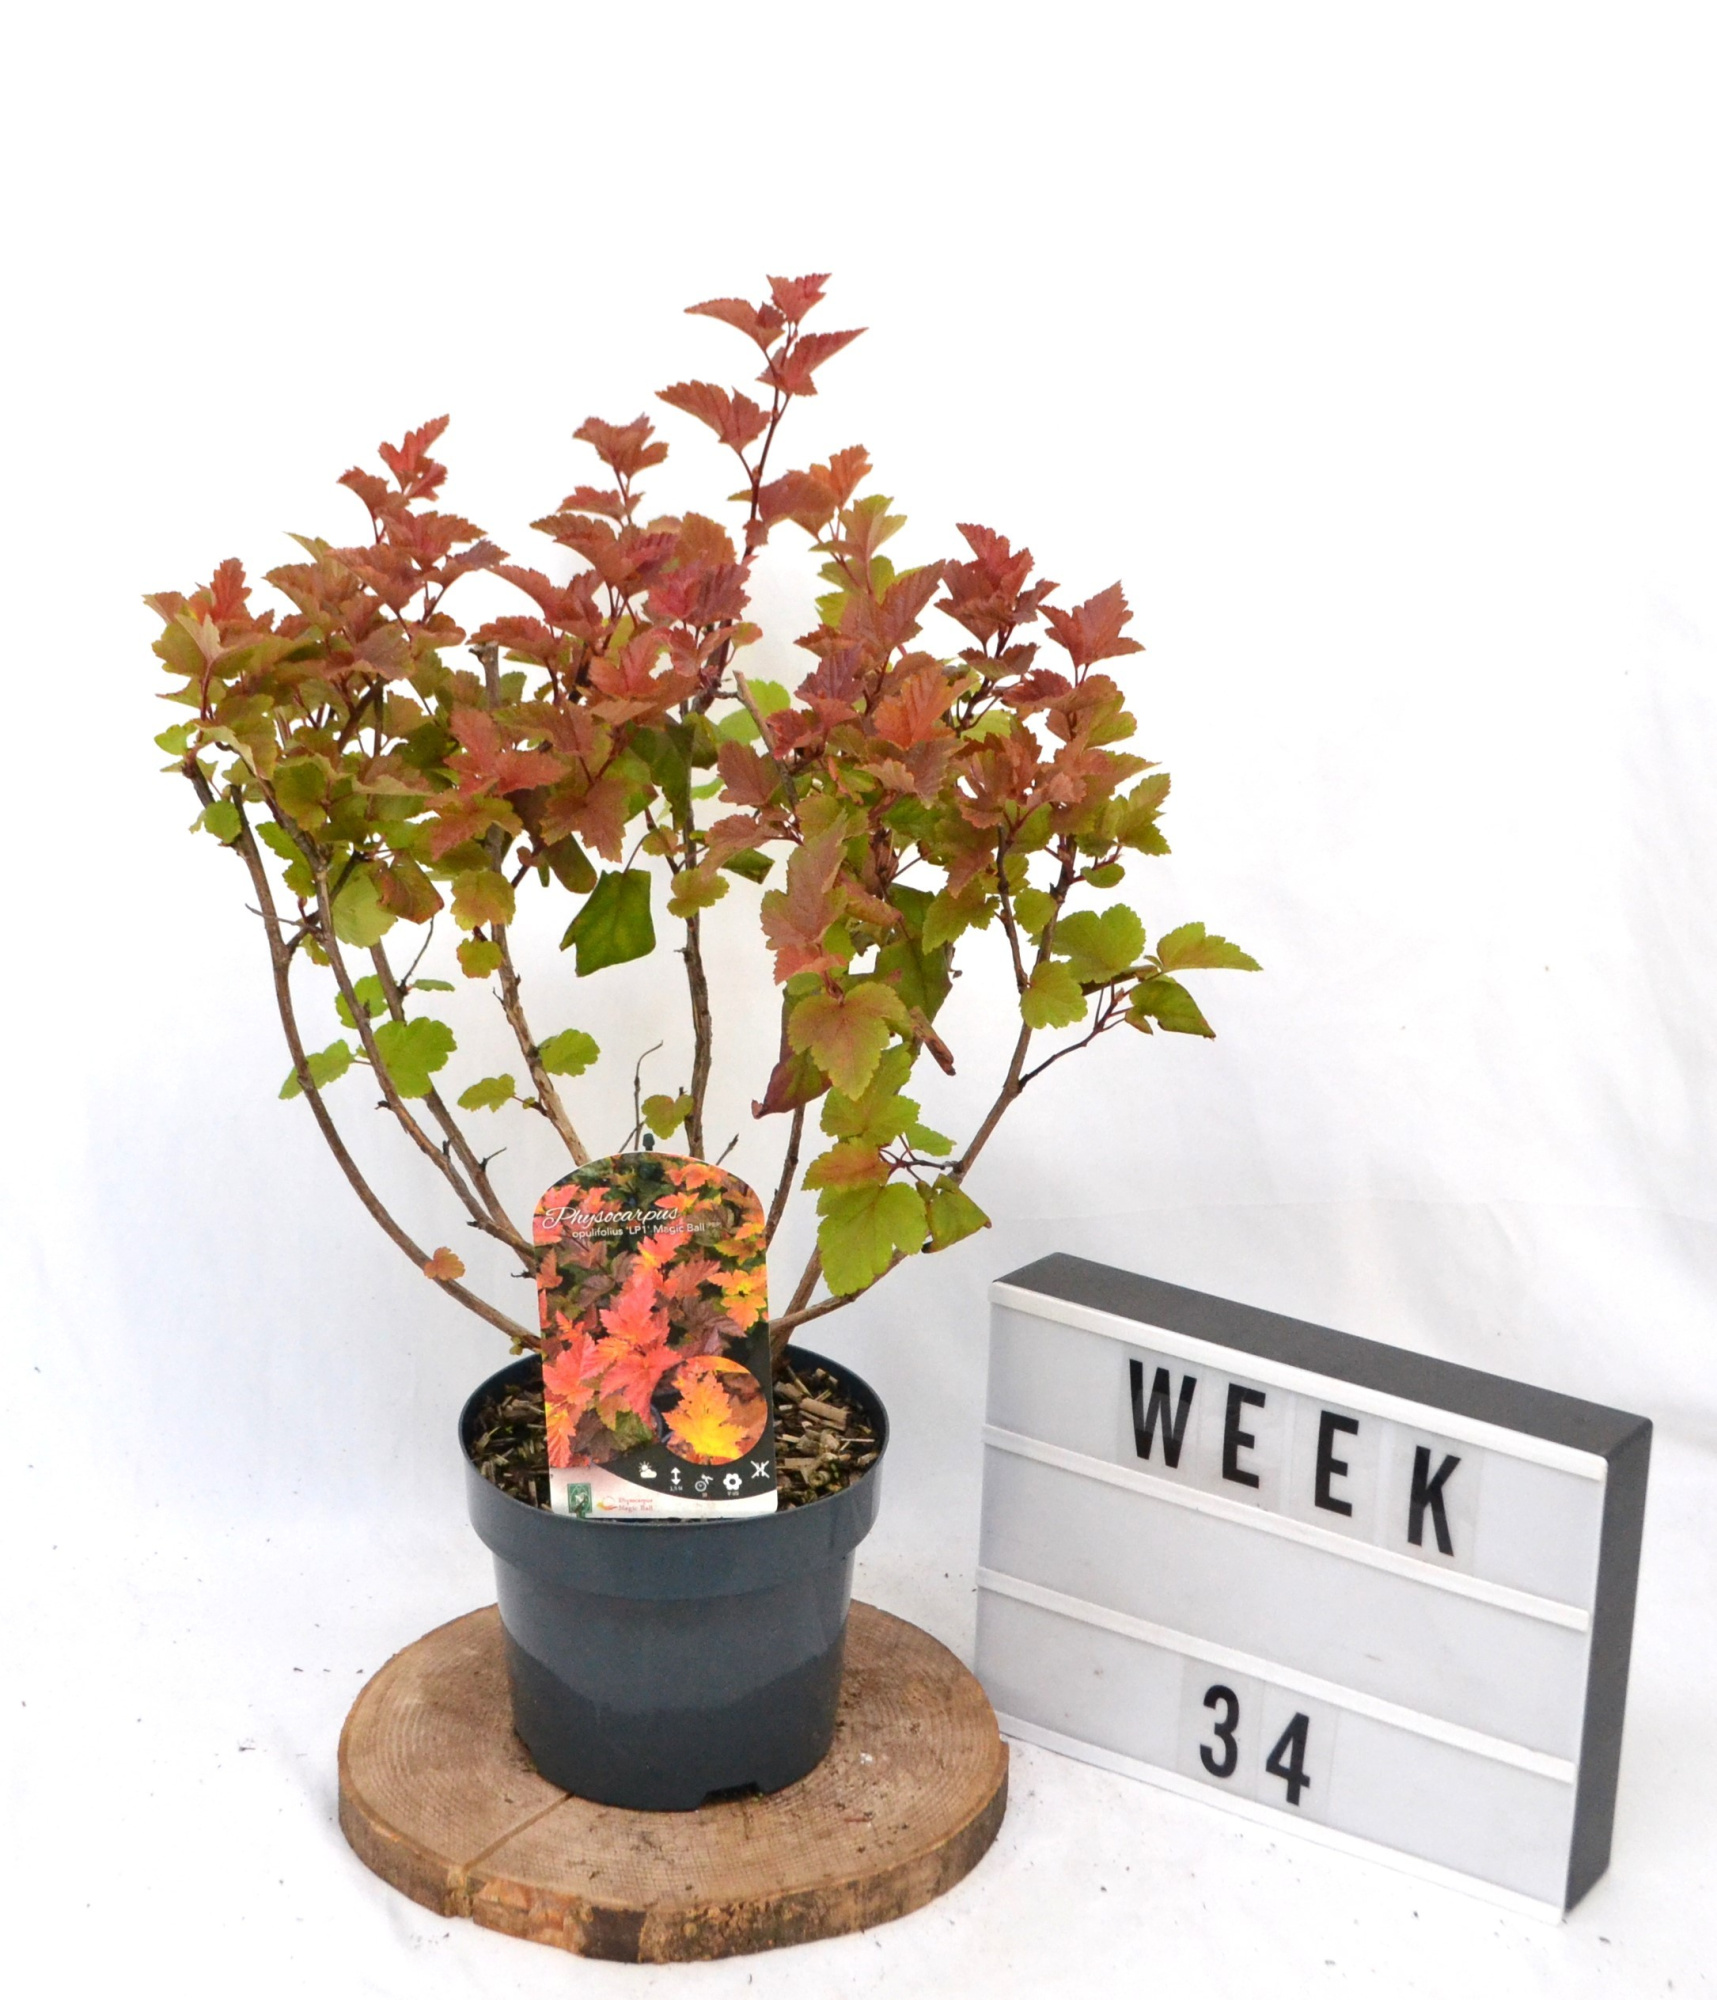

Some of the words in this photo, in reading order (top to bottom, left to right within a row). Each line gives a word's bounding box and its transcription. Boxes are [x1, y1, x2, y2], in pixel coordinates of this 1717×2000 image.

[542, 1206, 679, 1230] Physocarpus
[572, 1227, 624, 1240] opulifolius
[653, 1224, 684, 1236] Magic
[687, 1222, 705, 1233] Ball
[1128, 1358, 1461, 1557] WEEK
[1199, 1684, 1311, 1806] 34
